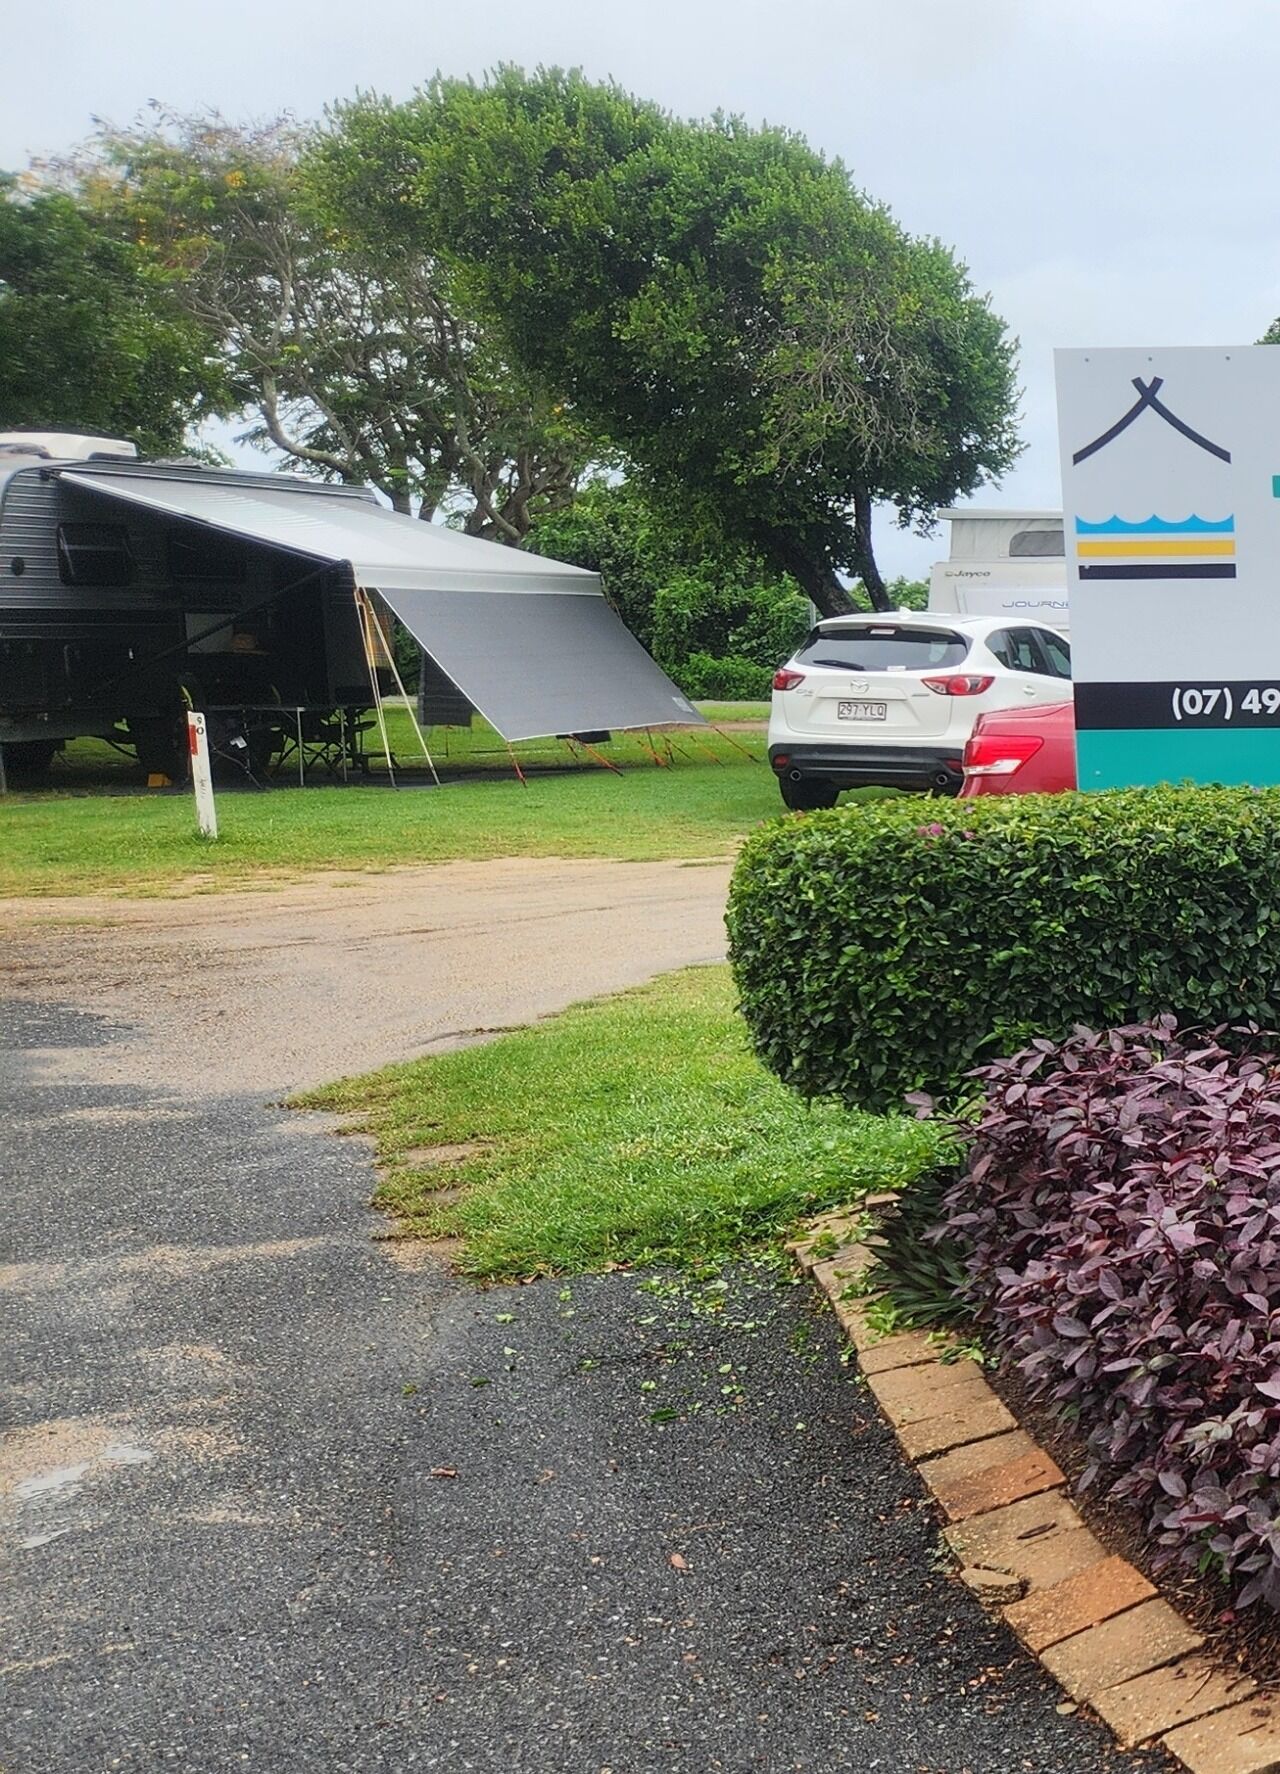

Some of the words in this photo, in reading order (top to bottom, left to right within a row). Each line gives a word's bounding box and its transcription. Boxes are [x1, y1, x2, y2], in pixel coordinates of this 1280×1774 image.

[953, 570, 991, 578] Jayco
[1001, 600, 1069, 609] JOURN
[1172, 687, 1234, 720] (07)
